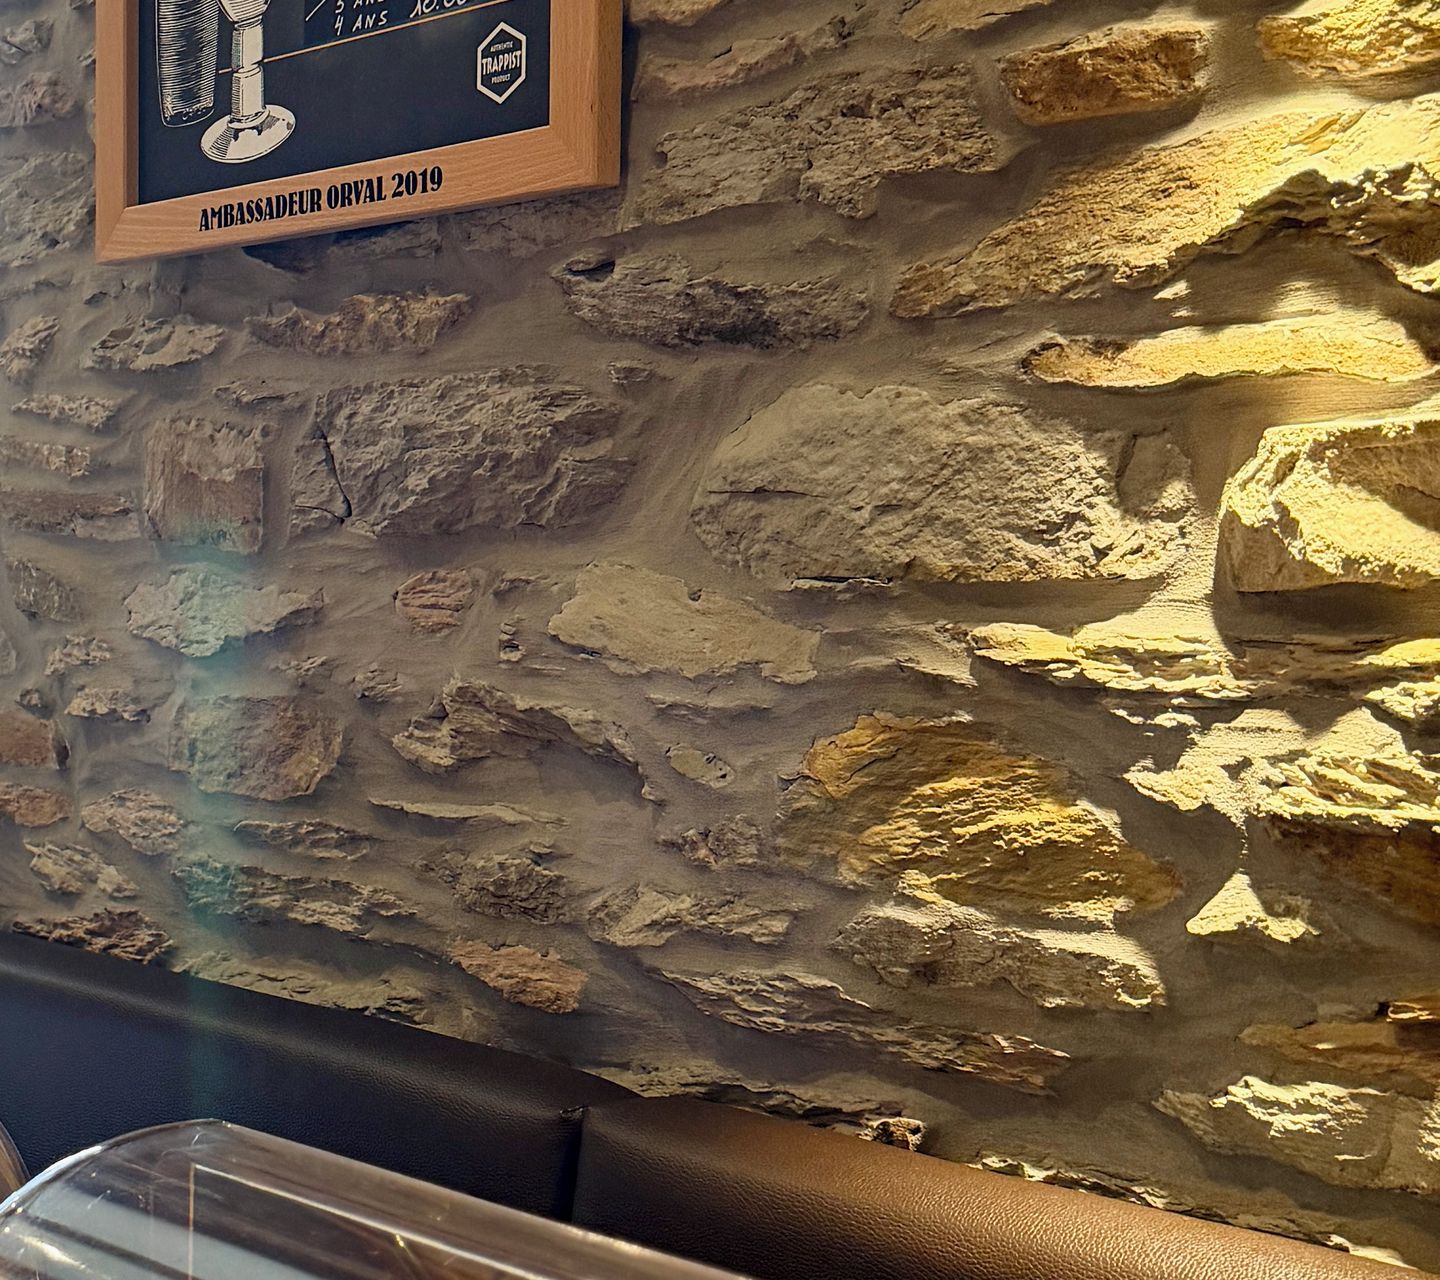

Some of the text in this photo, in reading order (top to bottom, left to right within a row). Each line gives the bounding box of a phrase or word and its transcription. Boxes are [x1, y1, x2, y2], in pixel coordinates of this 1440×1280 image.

[334, 16, 344, 36] 4
[352, 10, 388, 32] ANS
[482, 51, 521, 76] TRAPPIST
[199, 166, 443, 232] AMBASSADEUR ORVAL 2019
